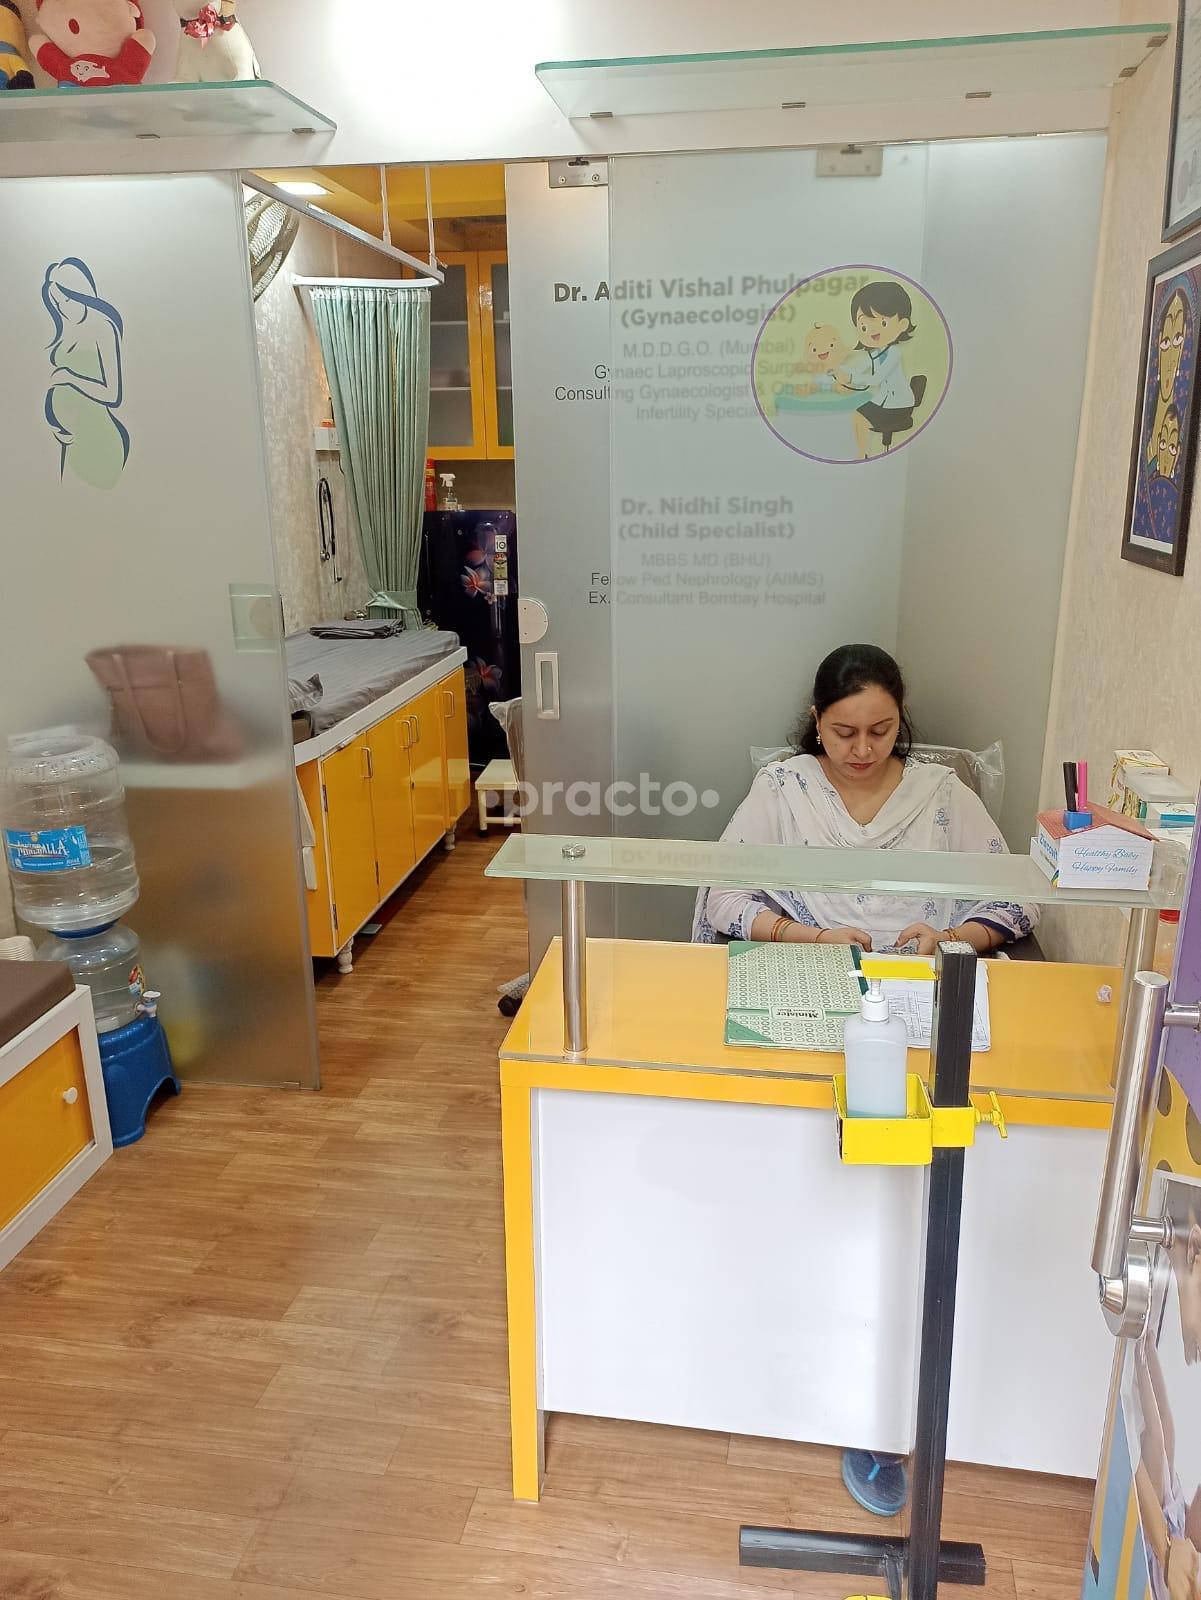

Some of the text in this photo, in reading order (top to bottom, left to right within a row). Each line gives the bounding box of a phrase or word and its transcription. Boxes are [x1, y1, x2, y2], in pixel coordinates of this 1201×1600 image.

[553, 272, 869, 302] Dr. Aditi Vishal Phulpagar
[658, 360, 751, 381] Laproscopic
[758, 359, 825, 377] Surgeon
[555, 385, 635, 404] Consultng
[640, 382, 751, 401] Gynaecologist
[636, 403, 779, 422] Infertility Speciast
[621, 495, 794, 518] Dr. Nidhi Singh
[619, 521, 795, 541] (Child Specialist)
[641, 551, 771, 568] MBBS MD (BHU)
[591, 570, 637, 586] Felow
[676, 570, 760, 589] Nephrology
[589, 589, 826, 609] Ex. Consultant Bombay Hospital
[1074, 847, 1112, 860] Healthy
[1072, 861, 1104, 873] Happy
